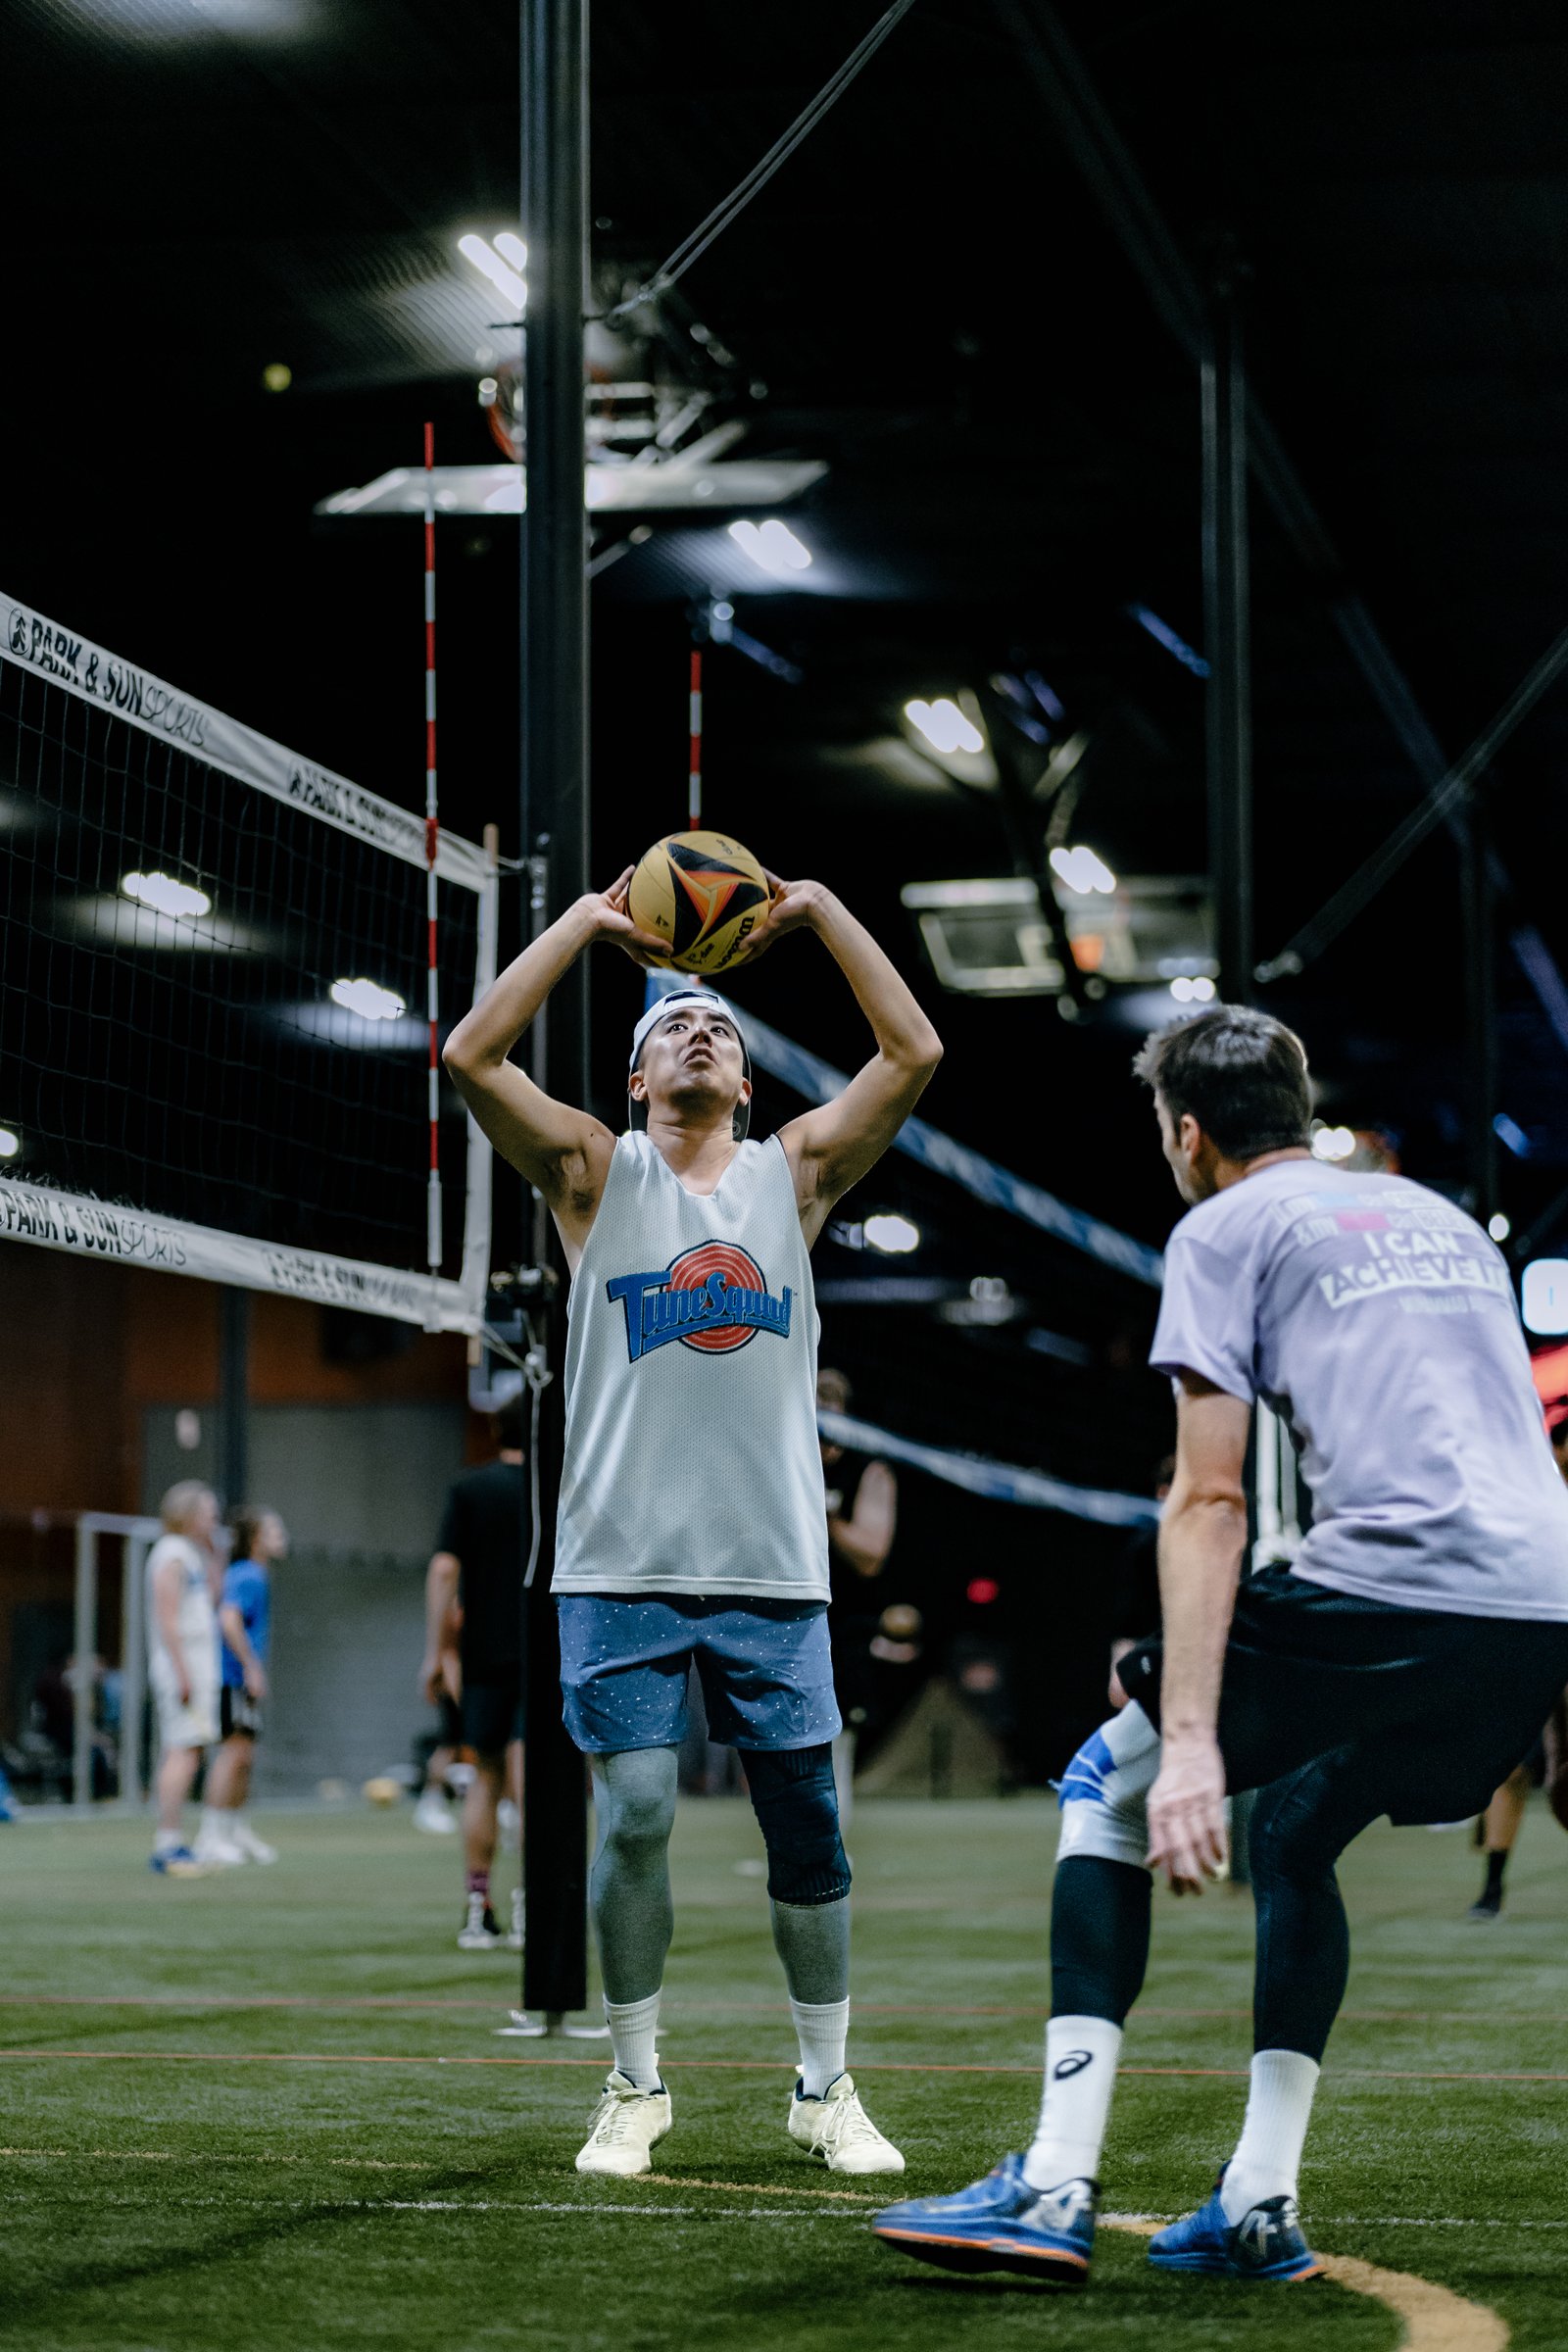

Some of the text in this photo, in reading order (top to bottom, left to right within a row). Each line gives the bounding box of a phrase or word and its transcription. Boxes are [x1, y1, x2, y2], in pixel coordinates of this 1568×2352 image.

[85, 652, 99, 694] &
[59, 1201, 78, 1245] &
[1362, 1231, 1382, 1257] I
[1384, 1231, 1462, 1256] CAN
[1330, 1255, 1477, 1301] ACHIEVE
